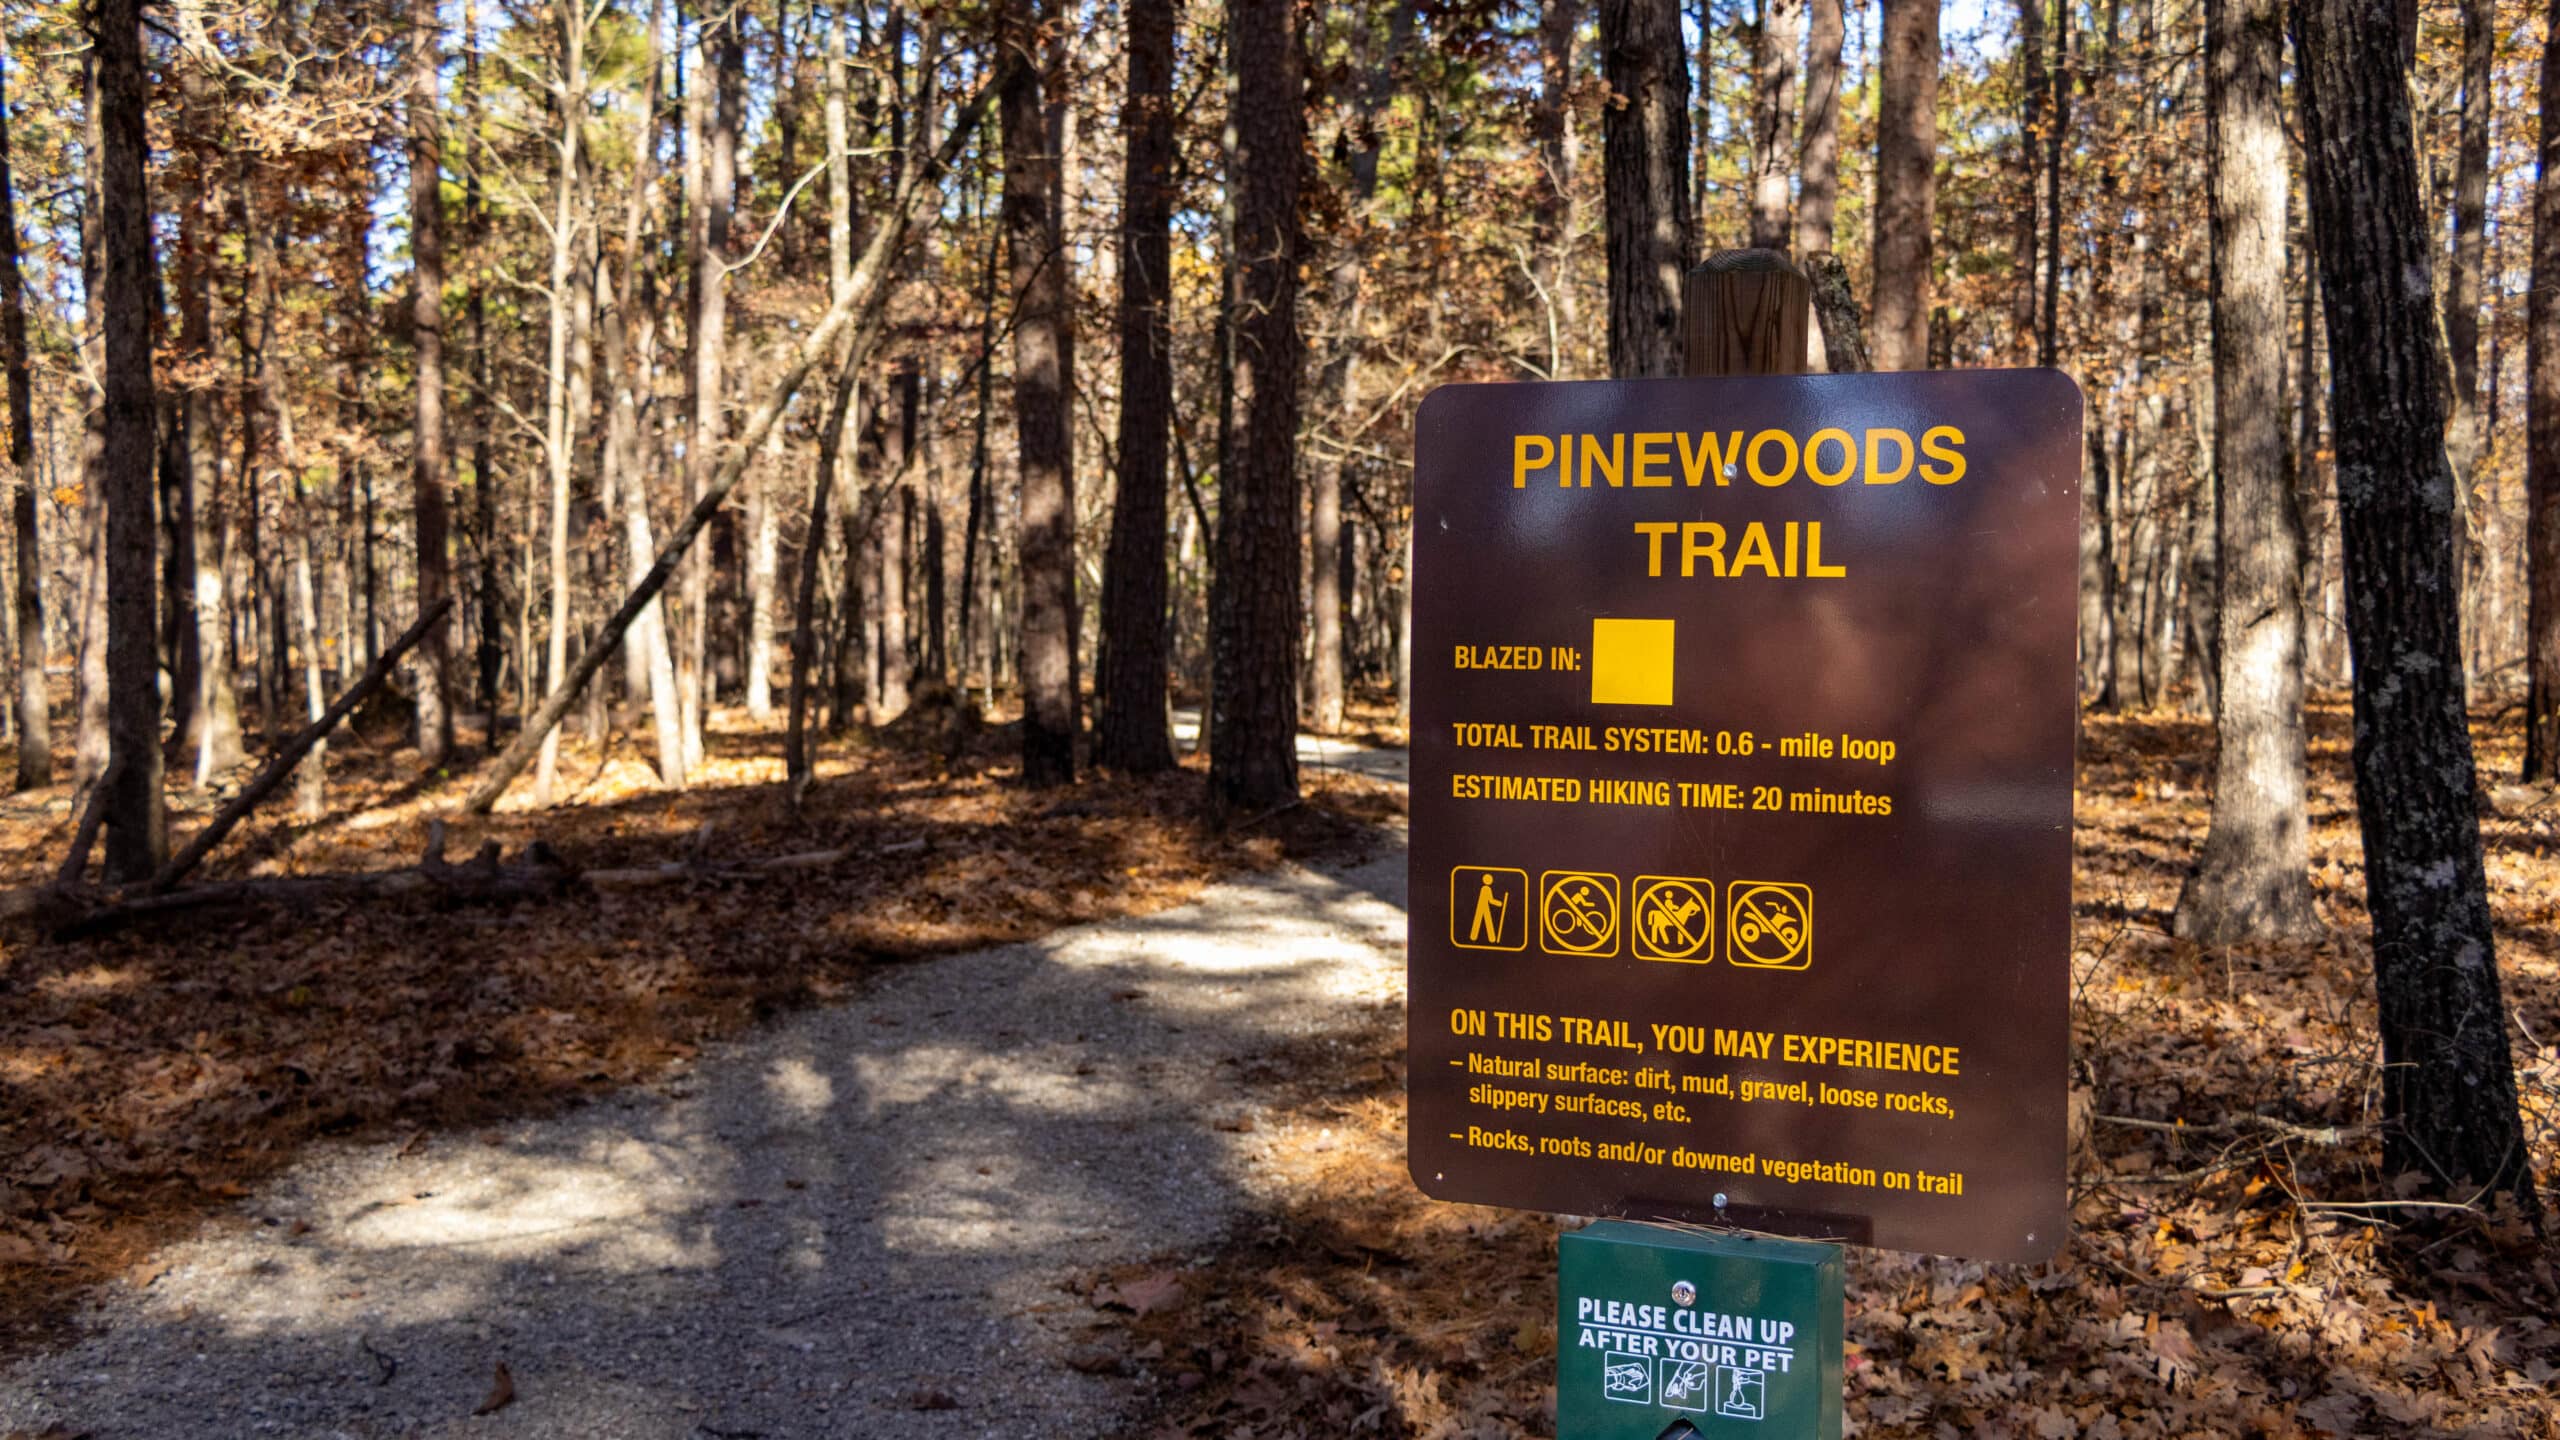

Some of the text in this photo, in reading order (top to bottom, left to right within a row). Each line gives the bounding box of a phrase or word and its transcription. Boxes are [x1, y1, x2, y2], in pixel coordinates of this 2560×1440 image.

[1513, 425, 1968, 489] PINEWOODS
[1634, 520, 1848, 579] TRAIL
[1454, 645, 1582, 671] BLAZED IN:
[1452, 722, 1524, 749] TOTAL
[1529, 725, 1598, 751] TRAIL
[1603, 726, 1709, 755] SYSTEM:
[1715, 730, 1755, 757] 0.6
[1779, 731, 1835, 759] mile
[1841, 733, 1897, 767] loop
[1452, 774, 1892, 816] ESTIMATED HIKING TIME: 20 minutes
[1450, 1008, 1960, 1076] ON THIS TRAIL, YOU MAY EXPERIENCE
[1468, 1052, 1541, 1079] Natural
[1546, 1061, 1629, 1086] surface:
[1634, 1066, 1677, 1095] dirt,
[1681, 1073, 1734, 1100] mud,
[1740, 1078, 1815, 1107] gravel,
[1819, 1081, 1879, 1110] loose
[1884, 1090, 1956, 1121] rocks,
[1469, 1083, 1692, 1124] slippery surfaces, etc.
[1468, 1125, 1535, 1156] Rocks,
[1540, 1136, 1592, 1158] roots
[1597, 1141, 1667, 1166] and/or
[1671, 1145, 1756, 1175] downed
[1761, 1158, 1877, 1188] vegetation
[1882, 1170, 1911, 1191] on
[1915, 1169, 1964, 1197] trail
[1578, 1297, 1794, 1345] PLEASE CLEAN UP
[1578, 1330, 1794, 1373] AFTER YOUR PET
